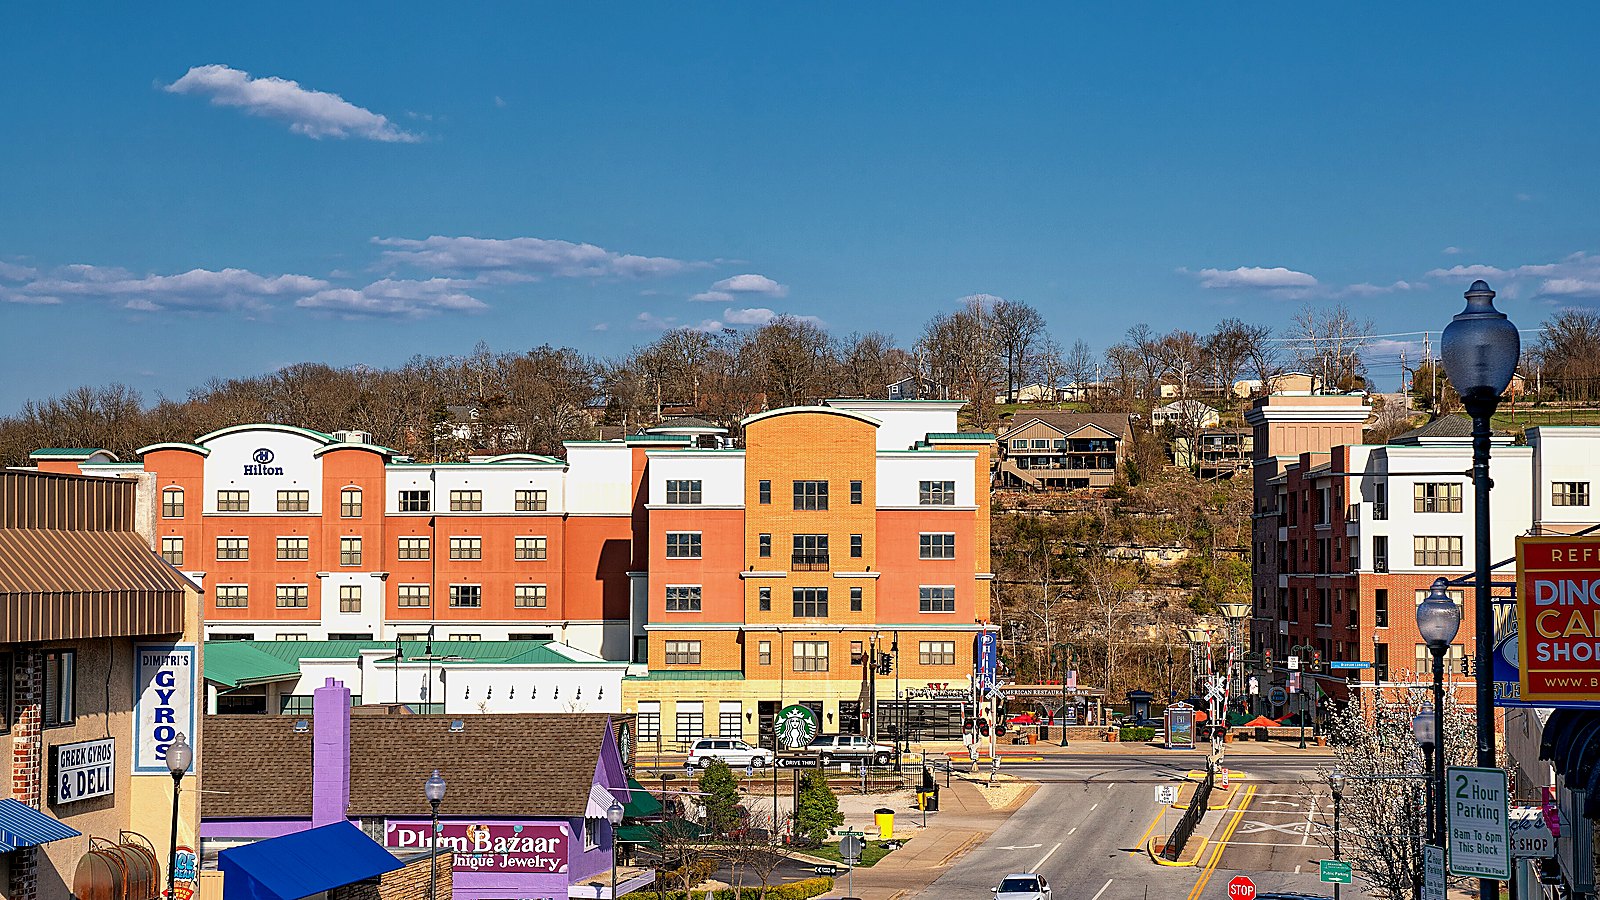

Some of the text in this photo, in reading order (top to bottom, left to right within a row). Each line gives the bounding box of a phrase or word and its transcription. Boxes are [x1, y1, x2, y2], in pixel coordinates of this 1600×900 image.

[243, 464, 284, 476] Hilton
[143, 655, 189, 666] DIMITRI'S
[153, 670, 176, 761] GYROS
[60, 743, 112, 768] GREEK GYROS
[60, 766, 110, 800] & DELI
[1455, 774, 1500, 802] 2 Hour
[1456, 801, 1500, 825] Parking
[473, 830, 561, 854] Bazaar
[1453, 828, 1502, 843] 8am To 6pm
[1520, 838, 1548, 851] SHOP
[1458, 841, 1498, 855] This Block
[500, 853, 562, 872] Jewelry
[1230, 884, 1254, 896] STOP
